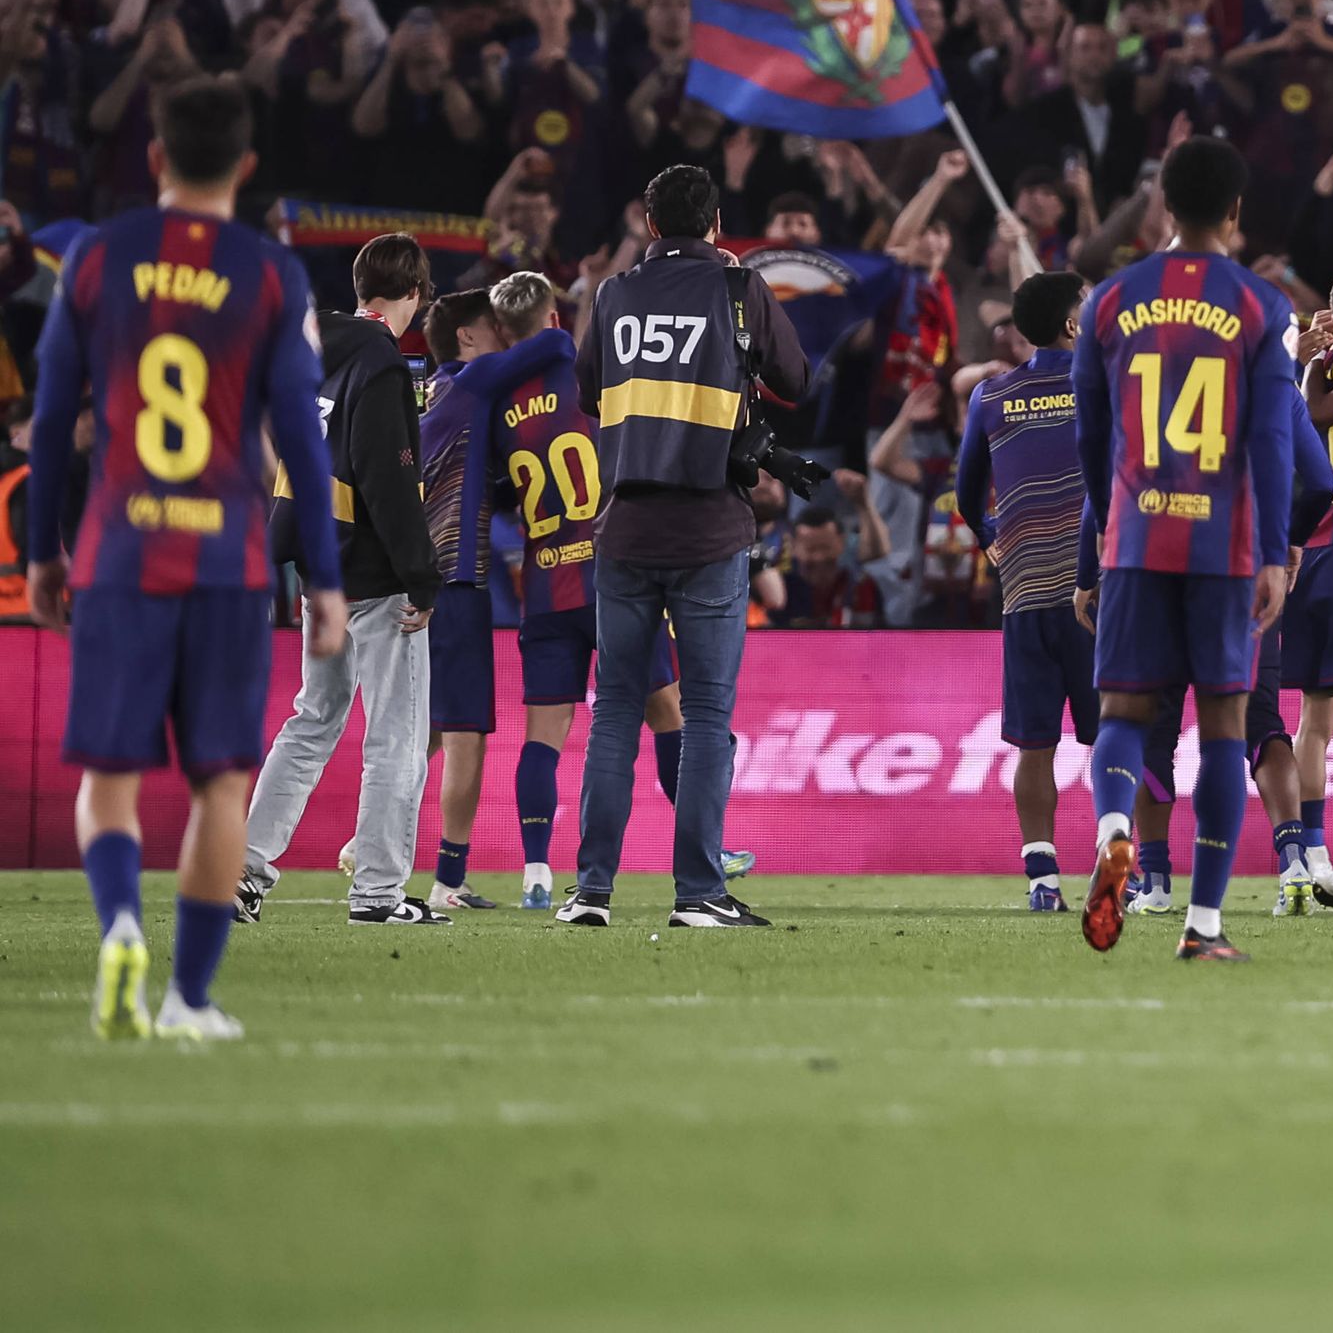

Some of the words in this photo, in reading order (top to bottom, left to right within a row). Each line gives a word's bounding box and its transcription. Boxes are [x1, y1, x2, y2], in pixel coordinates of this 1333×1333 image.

[613, 314, 707, 365] 057
[1117, 298, 1241, 342] RASHFORD
[135, 332, 212, 483] 8
[504, 393, 558, 428] OLMO
[1127, 352, 1226, 473] 14
[508, 431, 601, 539] 20
